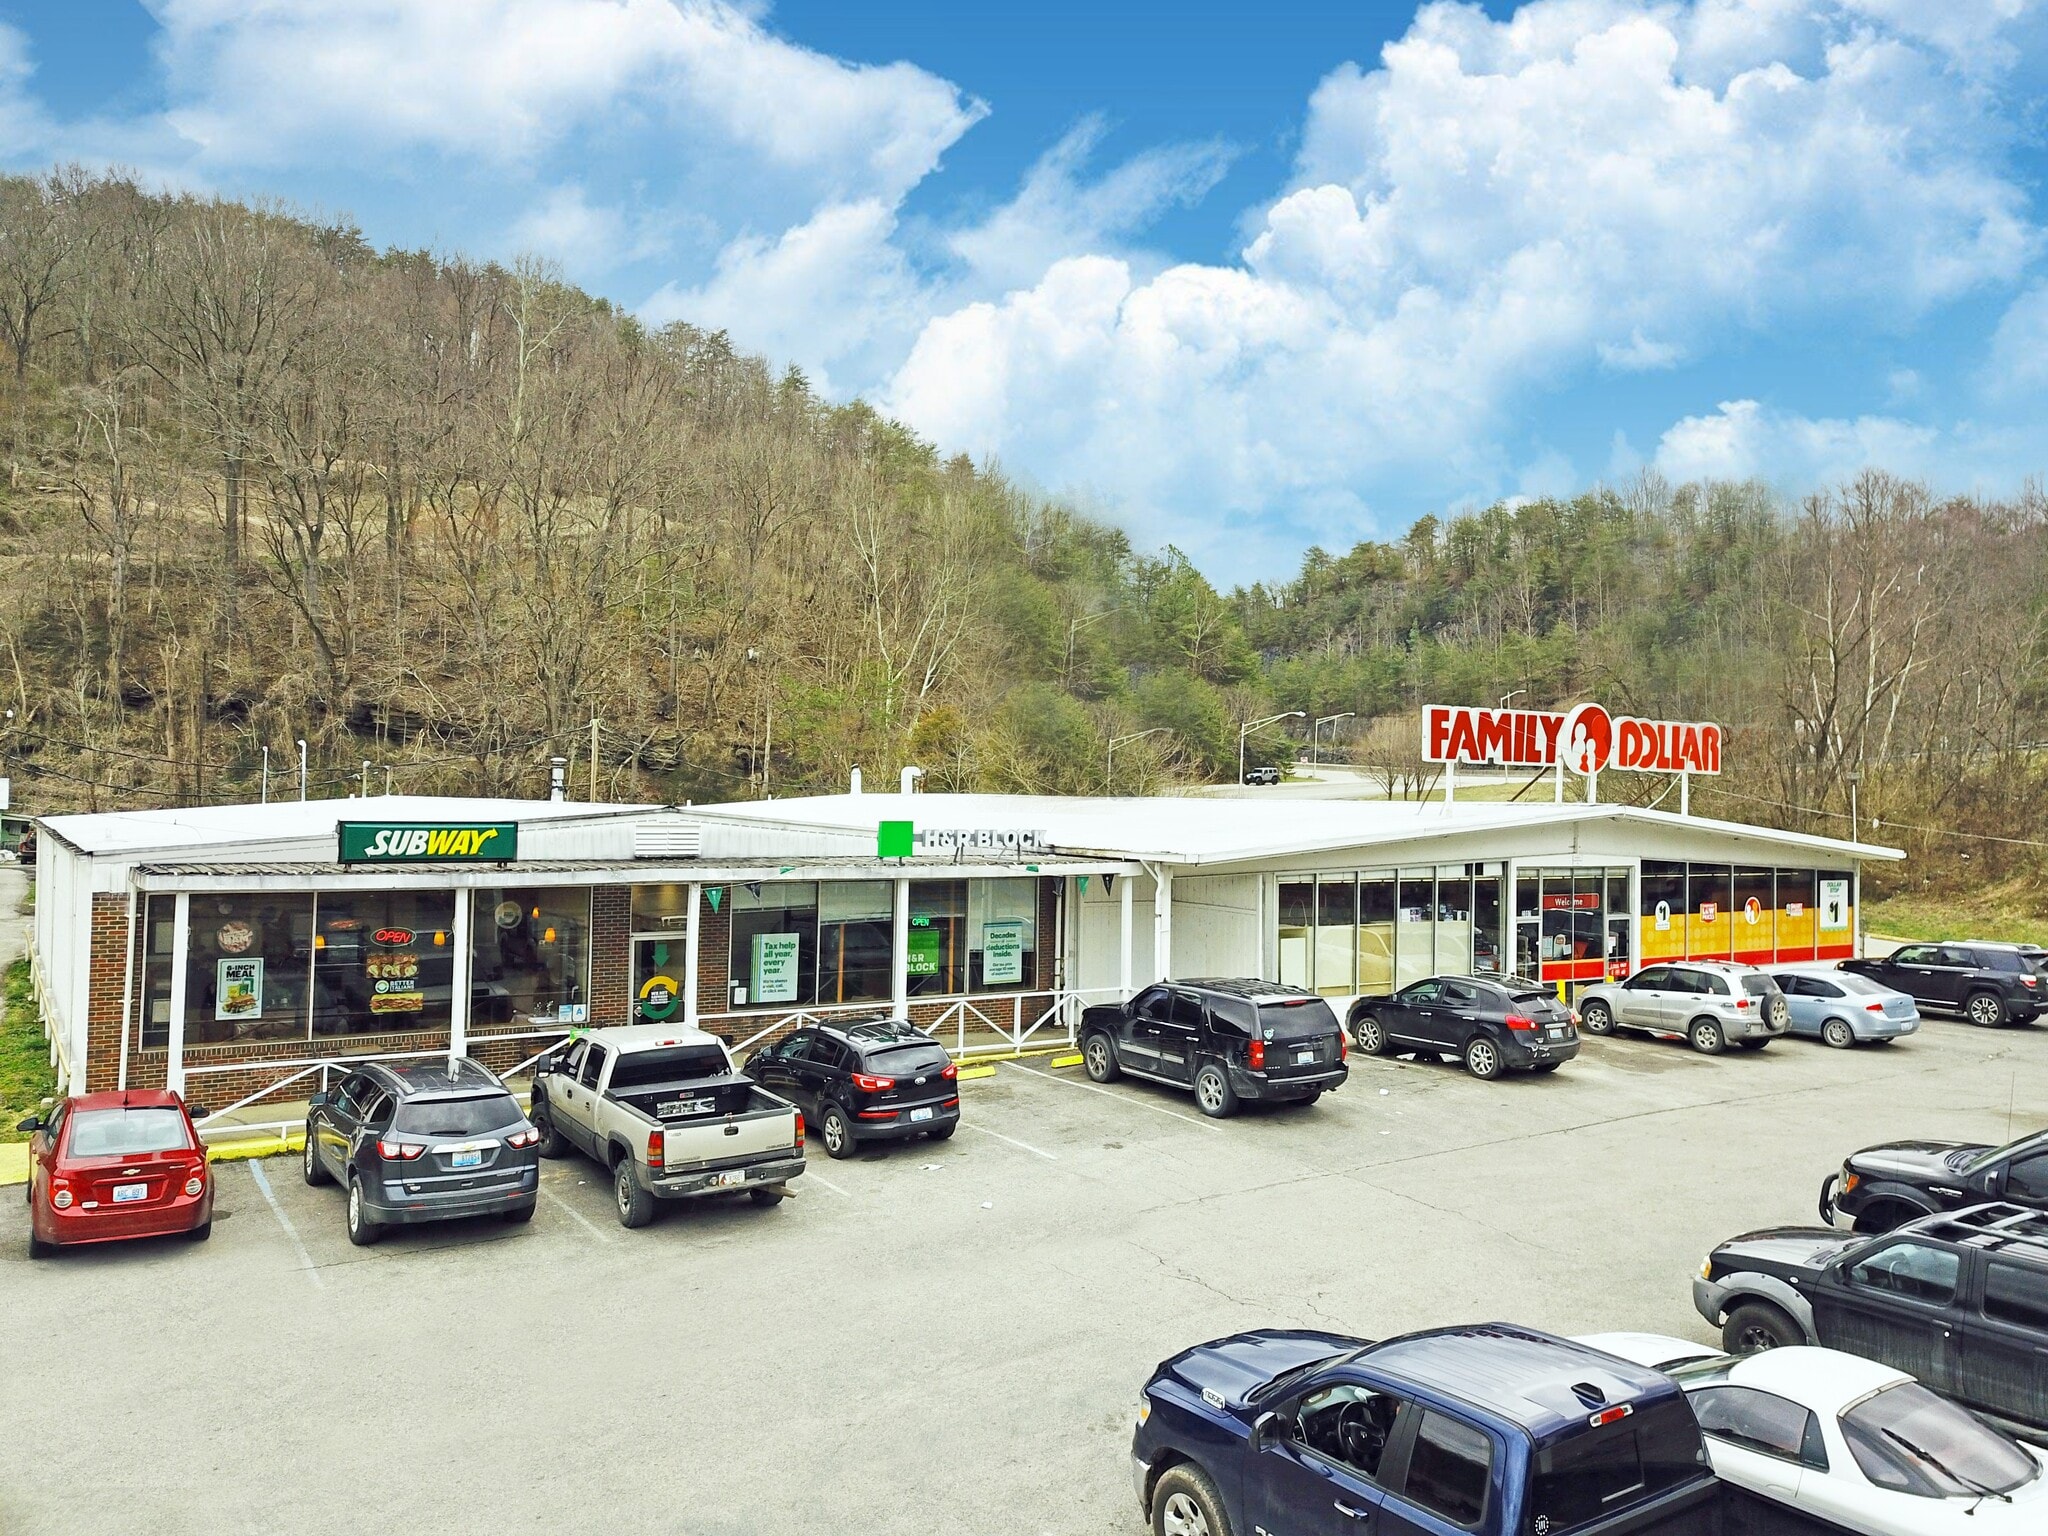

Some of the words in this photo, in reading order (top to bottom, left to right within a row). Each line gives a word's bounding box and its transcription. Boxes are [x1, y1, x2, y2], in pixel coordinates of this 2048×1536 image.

[1430, 709, 1566, 764] FAMILY
[1618, 720, 1719, 772] DOLLAR
[364, 827, 498, 857] SUBWAY
[921, 829, 972, 848] H&R
[974, 829, 1047, 848] BLOCK
[1555, 897, 1583, 906] Welcme
[1659, 906, 1666, 921] $1
[1829, 901, 1839, 923] $1
[912, 918, 930, 926] OPEN
[376, 931, 411, 943] OPEN
[779, 942, 796, 950] help
[986, 943, 1020, 951] deductions
[226, 970, 255, 978] MEAL
[576, 1007, 582, 1015] A
